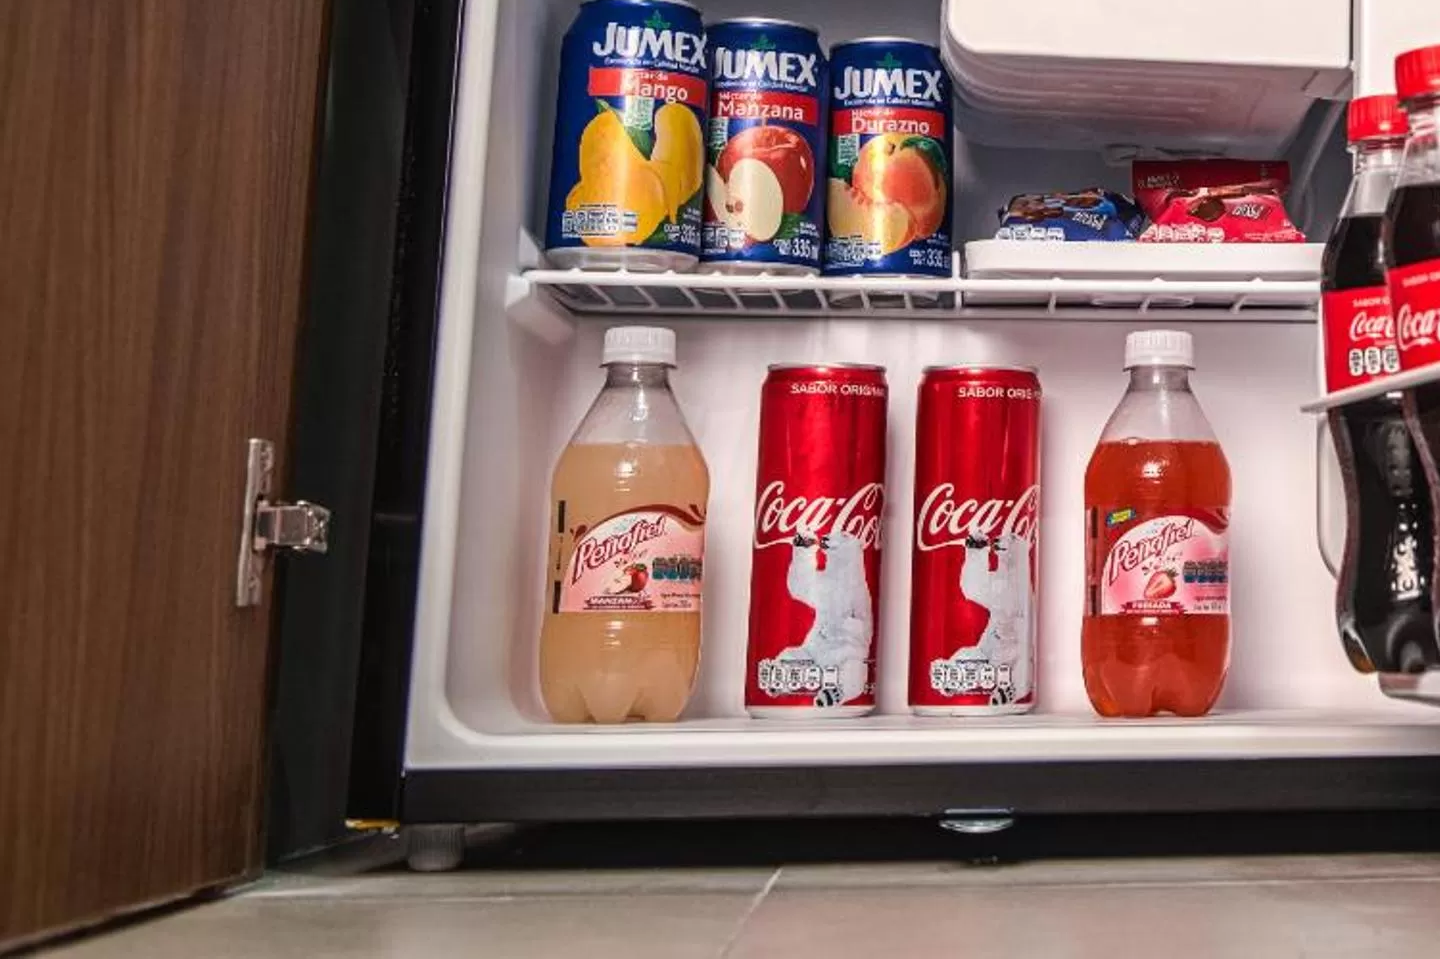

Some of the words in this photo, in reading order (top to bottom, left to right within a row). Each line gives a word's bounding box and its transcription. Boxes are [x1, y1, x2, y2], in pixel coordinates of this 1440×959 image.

[592, 22, 707, 69] JUMEX
[714, 46, 817, 88] JUMEX
[833, 65, 942, 102] JUMEX
[718, 100, 804, 121] Manzana
[851, 117, 930, 135] Durazno
[790, 381, 837, 395] SABOR
[957, 386, 1005, 399] SABOR
